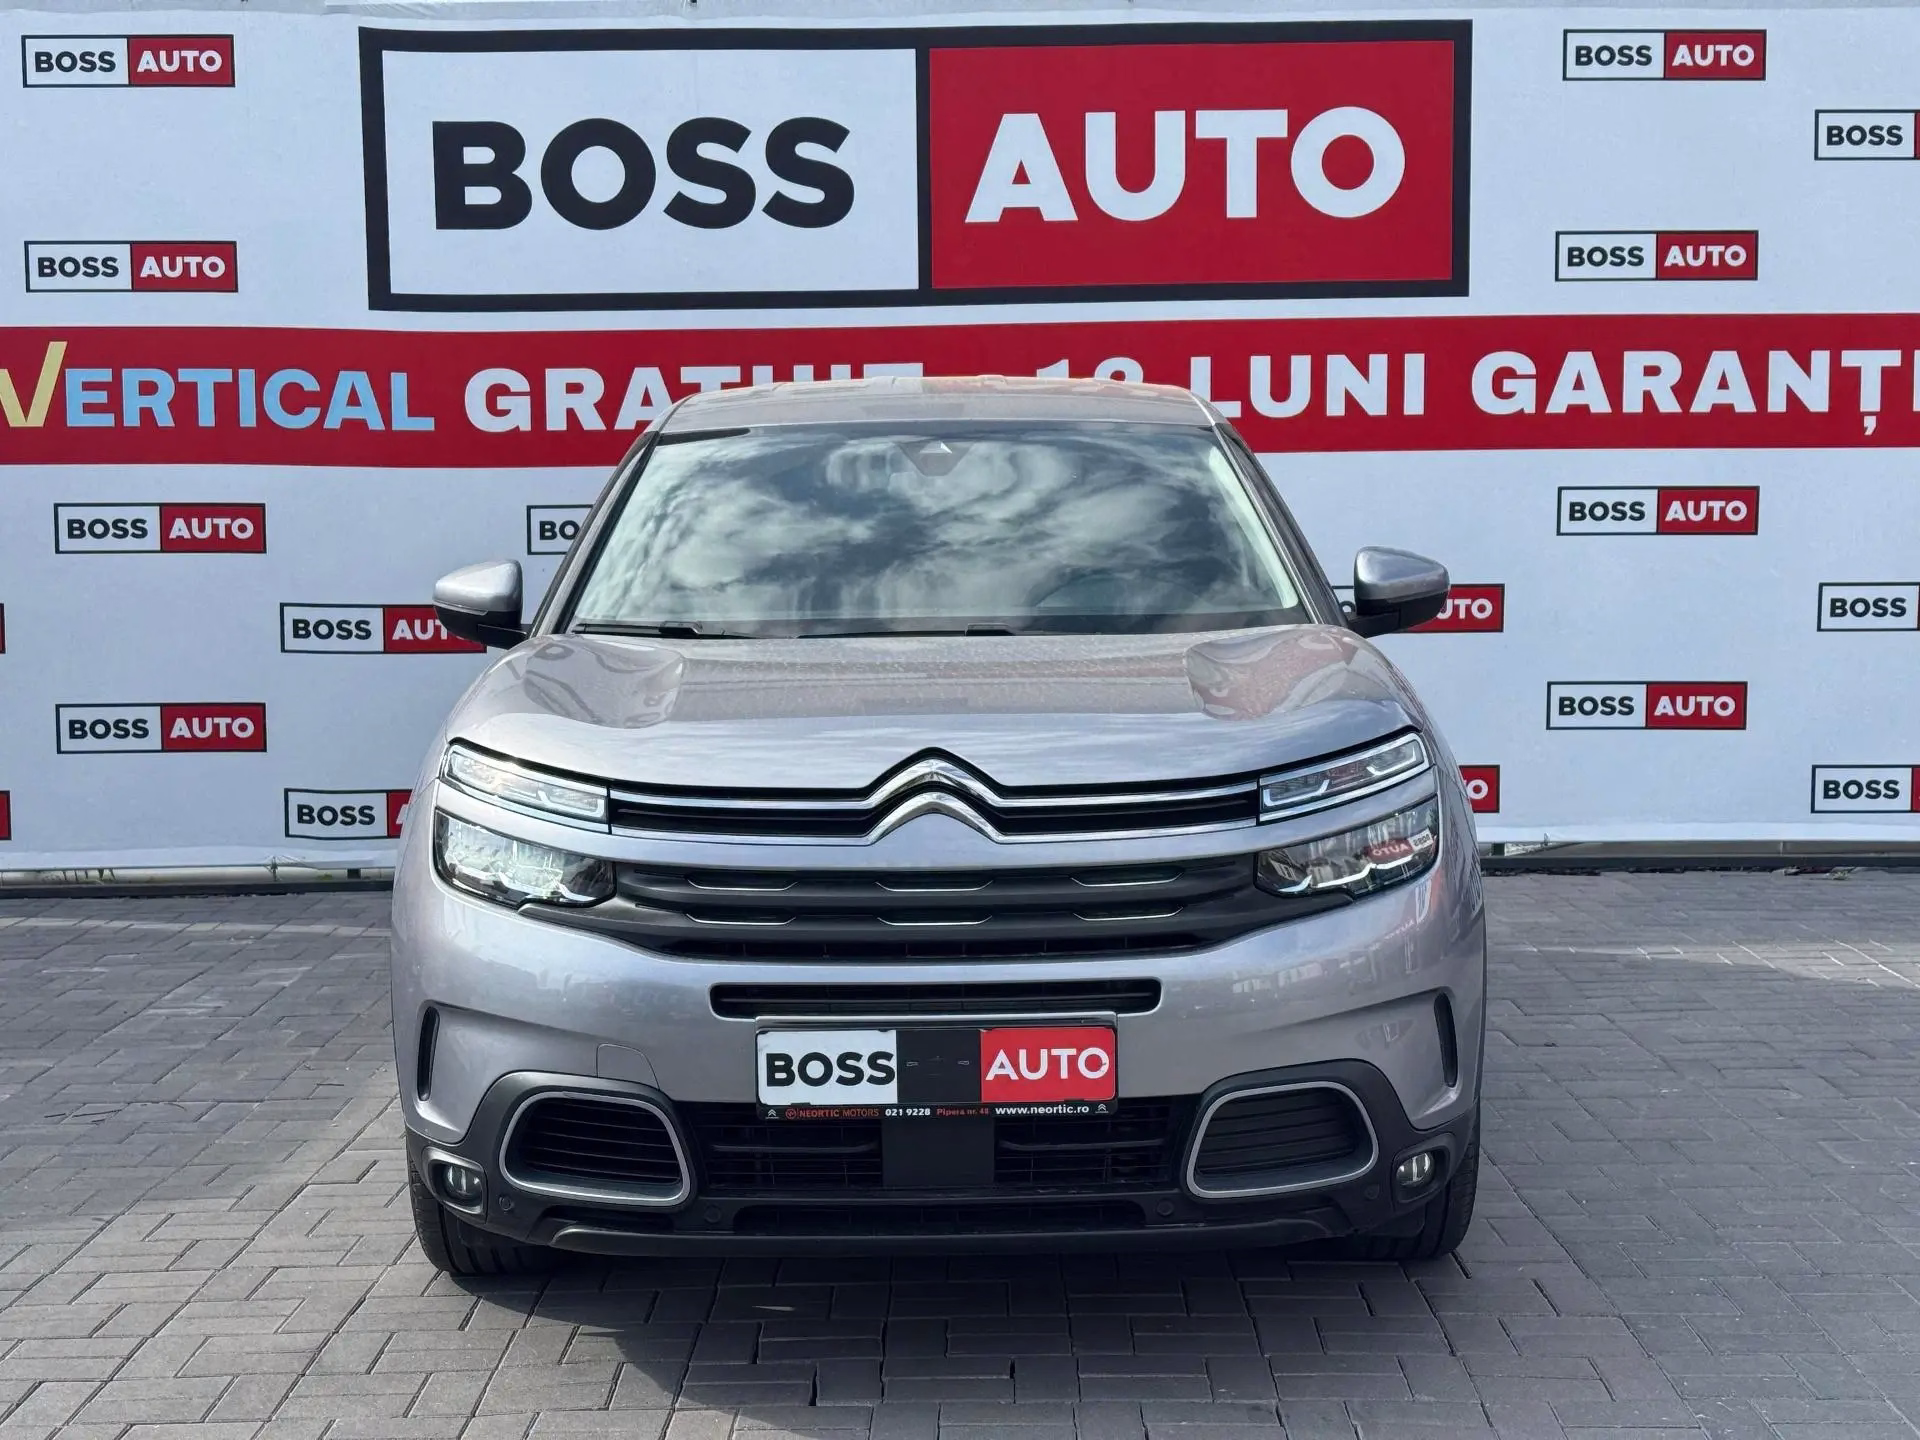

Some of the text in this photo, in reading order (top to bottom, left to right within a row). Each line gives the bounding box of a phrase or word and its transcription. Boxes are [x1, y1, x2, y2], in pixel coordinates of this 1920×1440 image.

[34, 50, 223, 73] BOSS AUTO
[1575, 44, 1755, 67] BOSS AUTO
[1826, 125, 1903, 146] BOSS
[432, 106, 1406, 231] BOSS AUTO
[1567, 245, 1747, 267] BOSS AUTO
[37, 256, 226, 279] BOSS AUTO
[0, 341, 435, 431] VERTICAL
[1190, 353, 1425, 418] LUNI
[1568, 500, 1748, 522] BOSS AUTO
[67, 518, 254, 540] BOSS AUTO
[539, 520, 580, 541] BO
[1437, 598, 1493, 620] UTO
[1829, 597, 1907, 618] BOSS
[292, 618, 372, 641] BOSS
[1558, 695, 1736, 717] BOSS AUTO
[68, 717, 255, 740] BOSS AUTO
[1823, 779, 1900, 800] BOSS
[296, 804, 376, 827] BOSS
[766, 1046, 1110, 1088] BOSS AUTO
[799, 1108, 840, 1118] NEORTIC
[842, 1107, 880, 1117] MOTORS
[885, 1107, 903, 1117] 021
[906, 1107, 931, 1116] 9228
[995, 1104, 1090, 1115] www.neortic.ro
